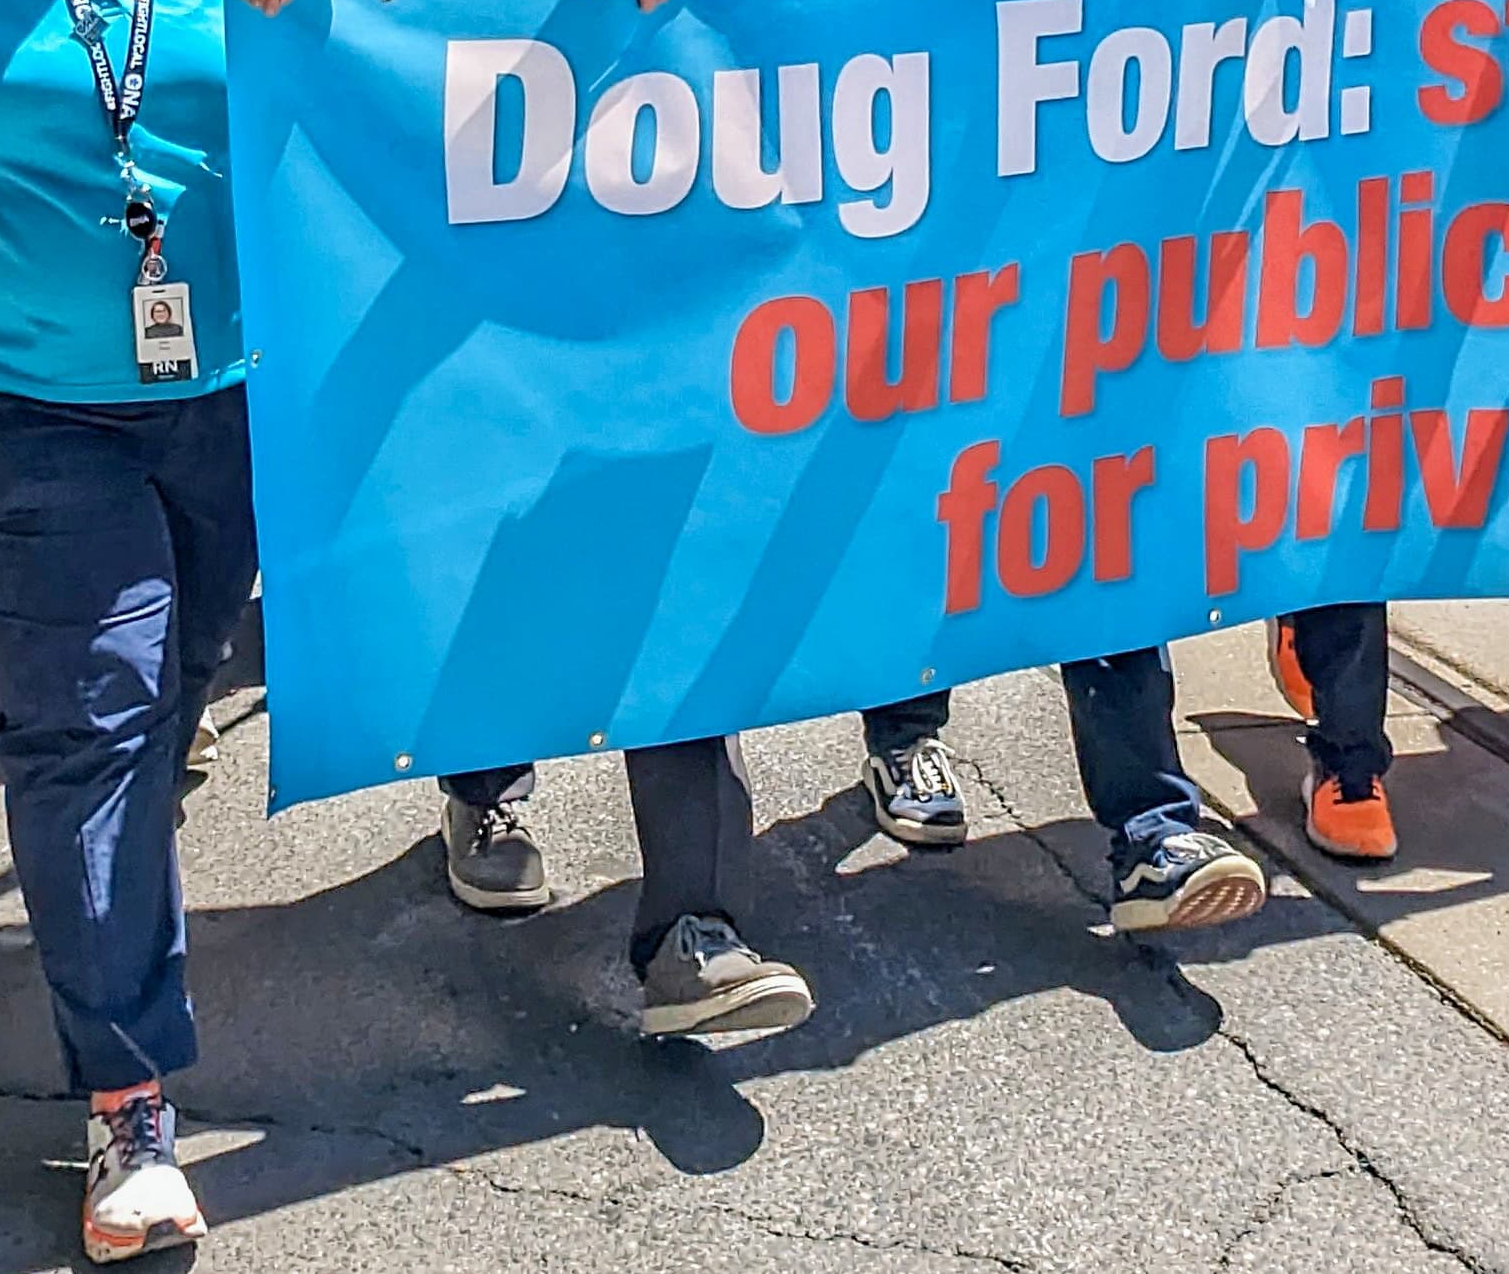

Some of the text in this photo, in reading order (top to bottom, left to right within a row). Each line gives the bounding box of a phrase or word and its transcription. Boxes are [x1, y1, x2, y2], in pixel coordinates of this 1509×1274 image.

[119, 72, 144, 120] ONA
[443, 39, 931, 238] Doug
[152, 359, 179, 376] RN
[729, 262, 1021, 436] our
[936, 438, 1155, 616] for
